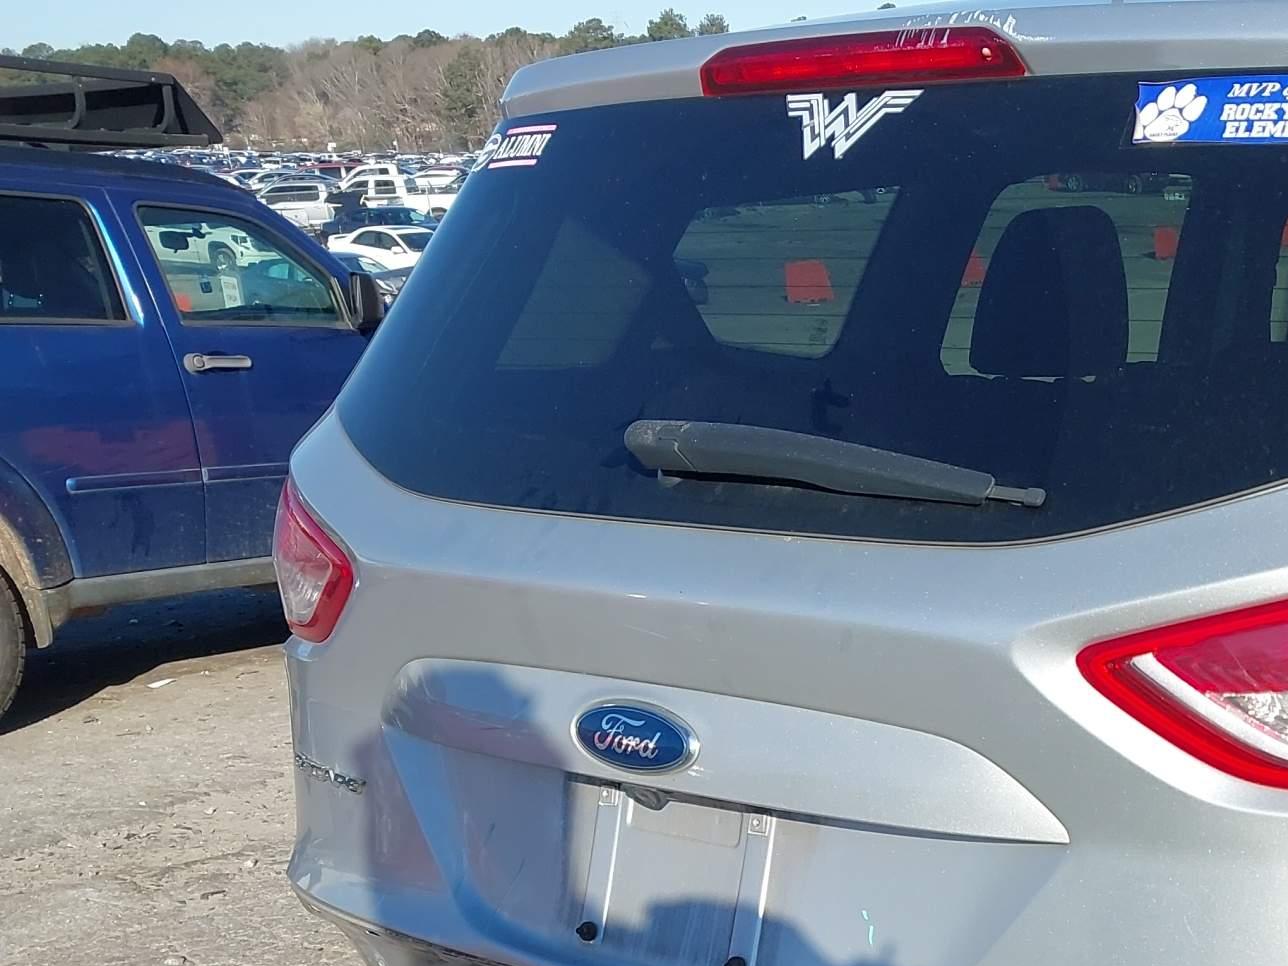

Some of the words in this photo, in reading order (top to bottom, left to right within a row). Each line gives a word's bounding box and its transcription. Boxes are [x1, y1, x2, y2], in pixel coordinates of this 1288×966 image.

[1226, 81, 1281, 98] MVP
[492, 133, 552, 160] ALUMNI
[593, 712, 661, 760] Ford
